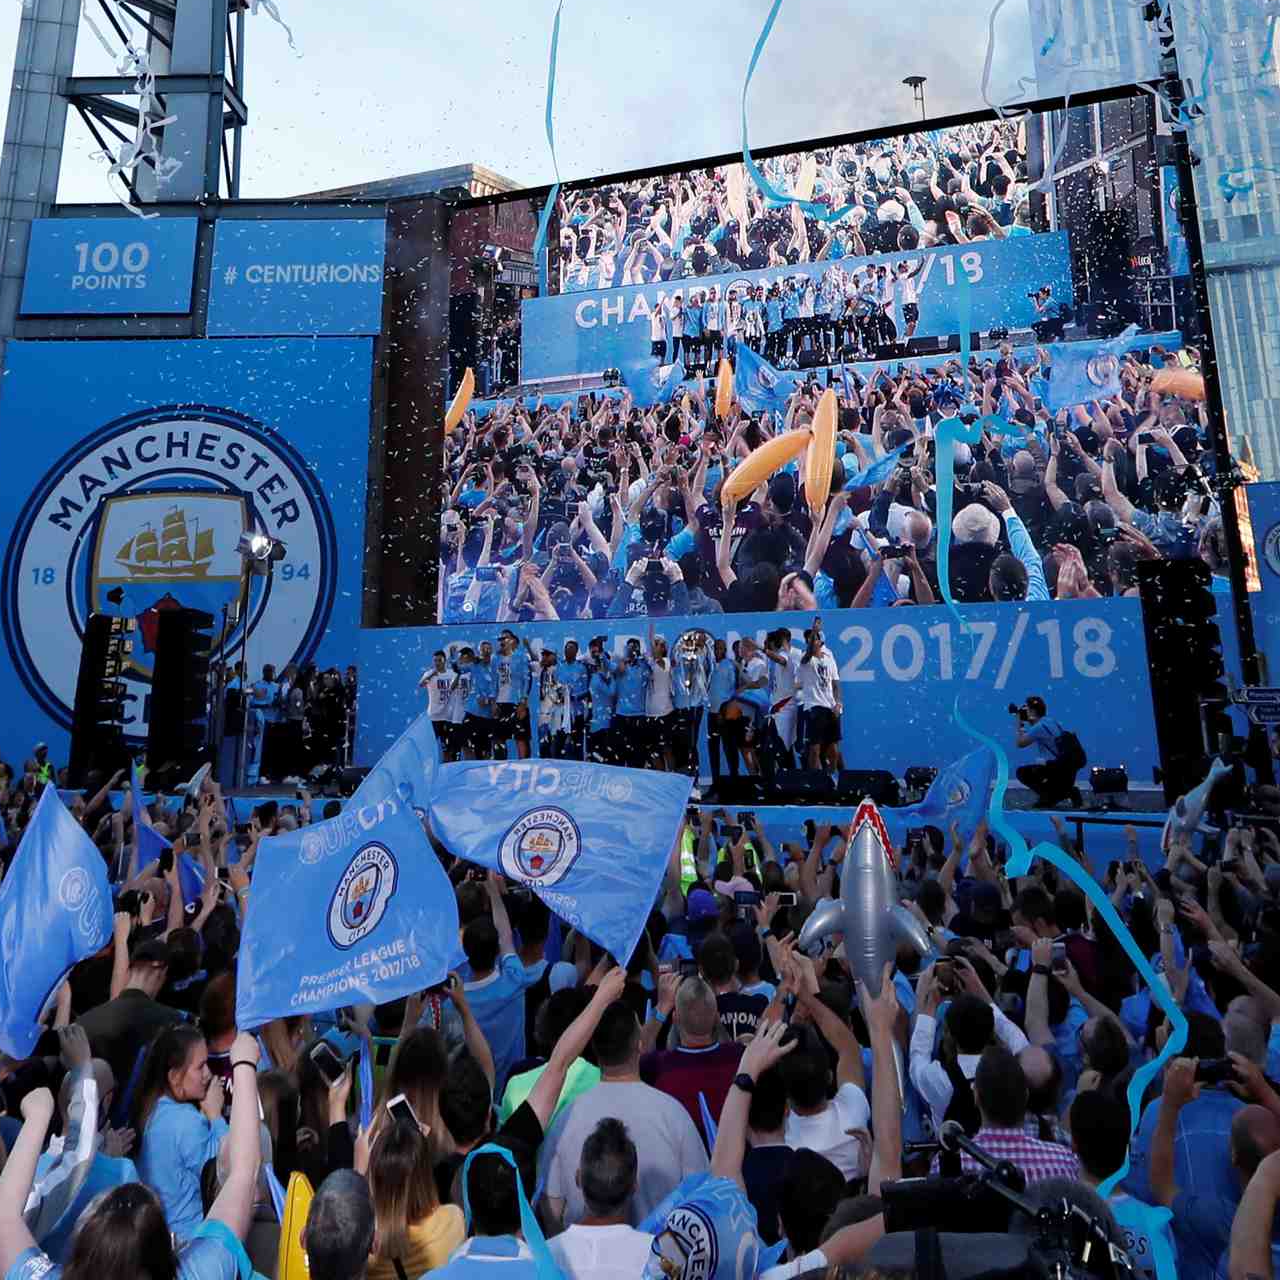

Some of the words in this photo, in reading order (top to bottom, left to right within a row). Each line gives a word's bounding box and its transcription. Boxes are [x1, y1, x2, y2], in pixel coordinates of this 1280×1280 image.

[76, 242, 150, 273] 100
[72, 274, 147, 290] POINTS
[245, 263, 380, 284] CENTURIONS
[48, 430, 301, 532] MANCHESTER
[31, 567, 56, 586] 18
[281, 563, 311, 582] 94
[838, 612, 1117, 690] 2017/18
[353, 938, 406, 967] LEAGUE
